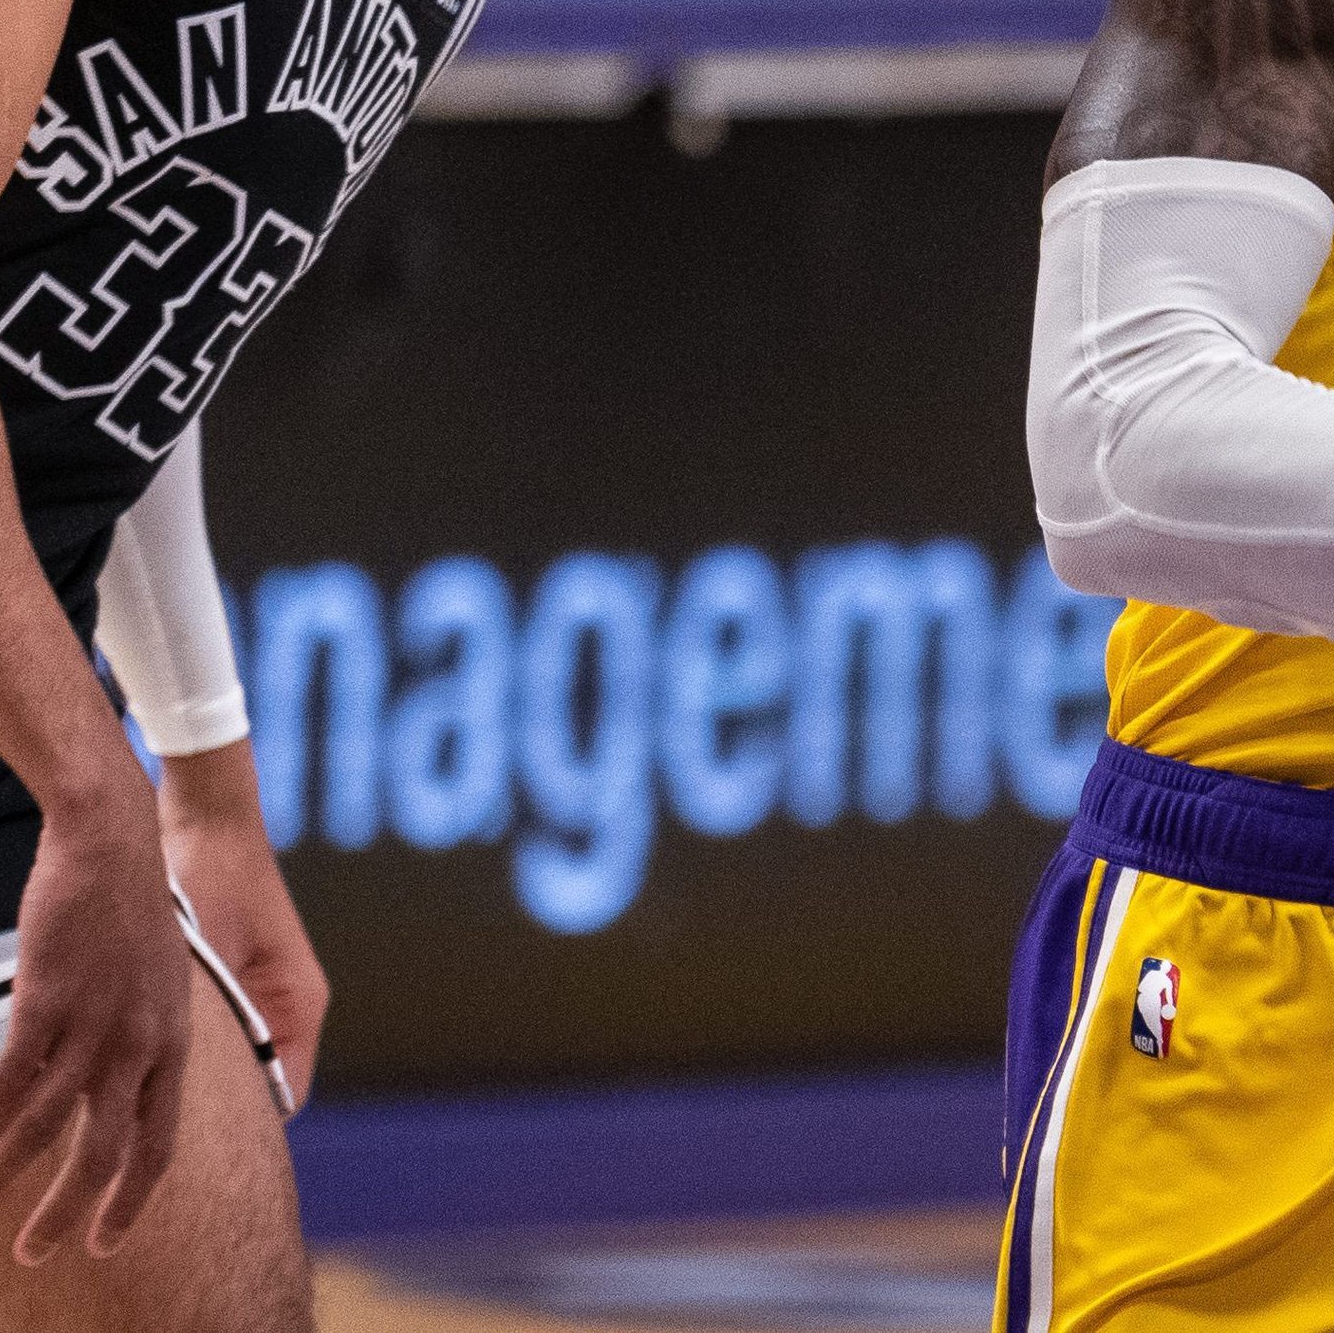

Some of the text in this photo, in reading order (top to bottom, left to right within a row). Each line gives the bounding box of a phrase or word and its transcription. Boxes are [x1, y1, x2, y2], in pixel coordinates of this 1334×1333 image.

[16, 2, 248, 213] SAN
[255, 535, 1111, 937] nageme
[1134, 1035, 1155, 1054] NBA
